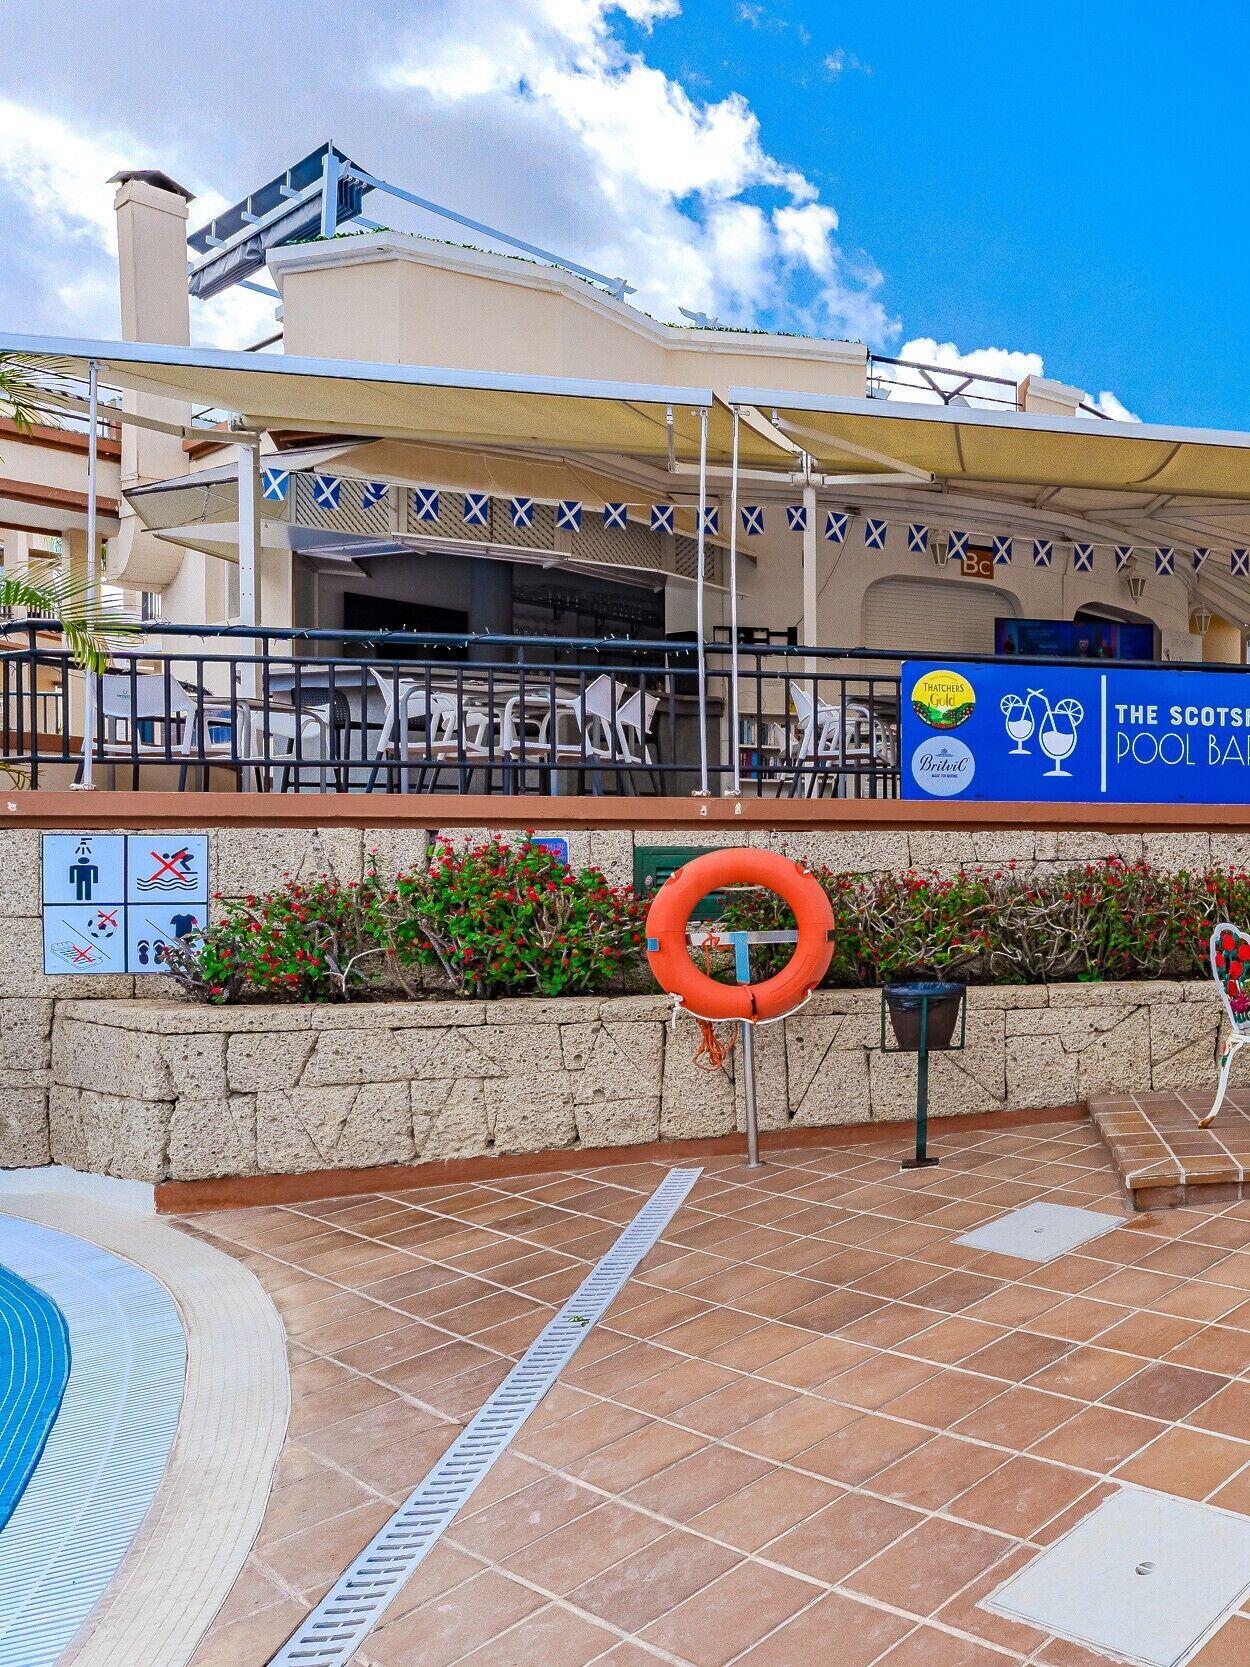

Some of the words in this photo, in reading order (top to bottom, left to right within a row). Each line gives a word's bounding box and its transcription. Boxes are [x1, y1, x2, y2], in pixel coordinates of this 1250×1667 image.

[923, 682, 965, 693] THATCHERS
[930, 692, 956, 708] Gold
[1115, 704, 1158, 725] THE
[1117, 731, 1196, 765] POOL
